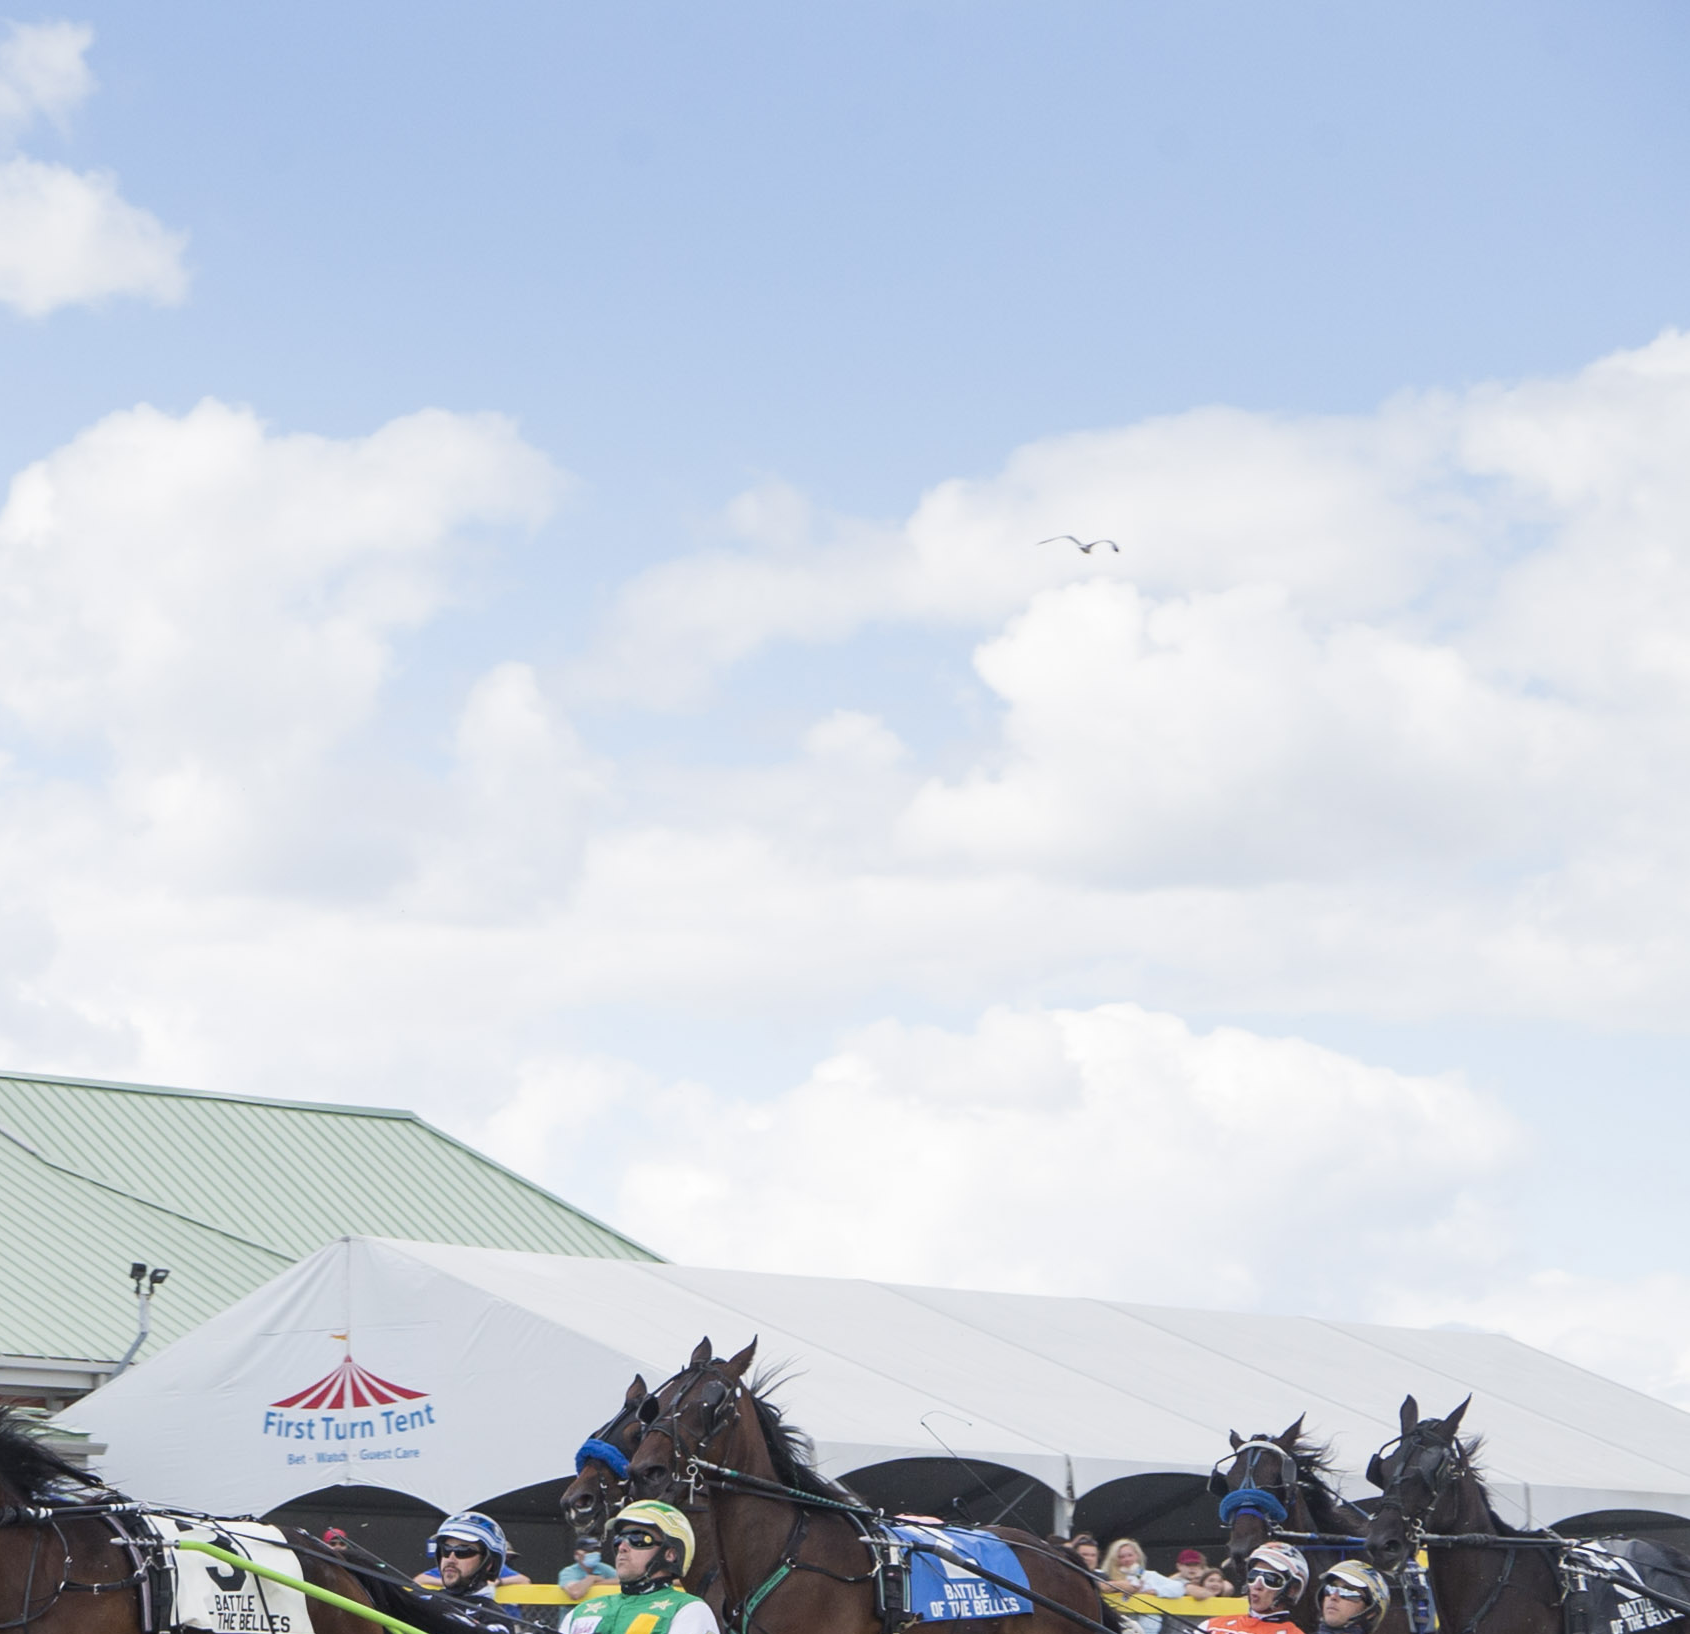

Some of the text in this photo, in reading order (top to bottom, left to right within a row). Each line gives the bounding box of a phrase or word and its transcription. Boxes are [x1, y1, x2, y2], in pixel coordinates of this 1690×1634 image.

[263, 1403, 436, 1440] First Turn Tent
[287, 1447, 420, 1465] Bet Watch Guest Care
[943, 1583, 990, 1600] BATTLE
[214, 1594, 255, 1613] BATTLE
[929, 1601, 945, 1618] OF
[218, 1613, 291, 1633] THE BELLES
[1625, 1614, 1647, 1632] THE
